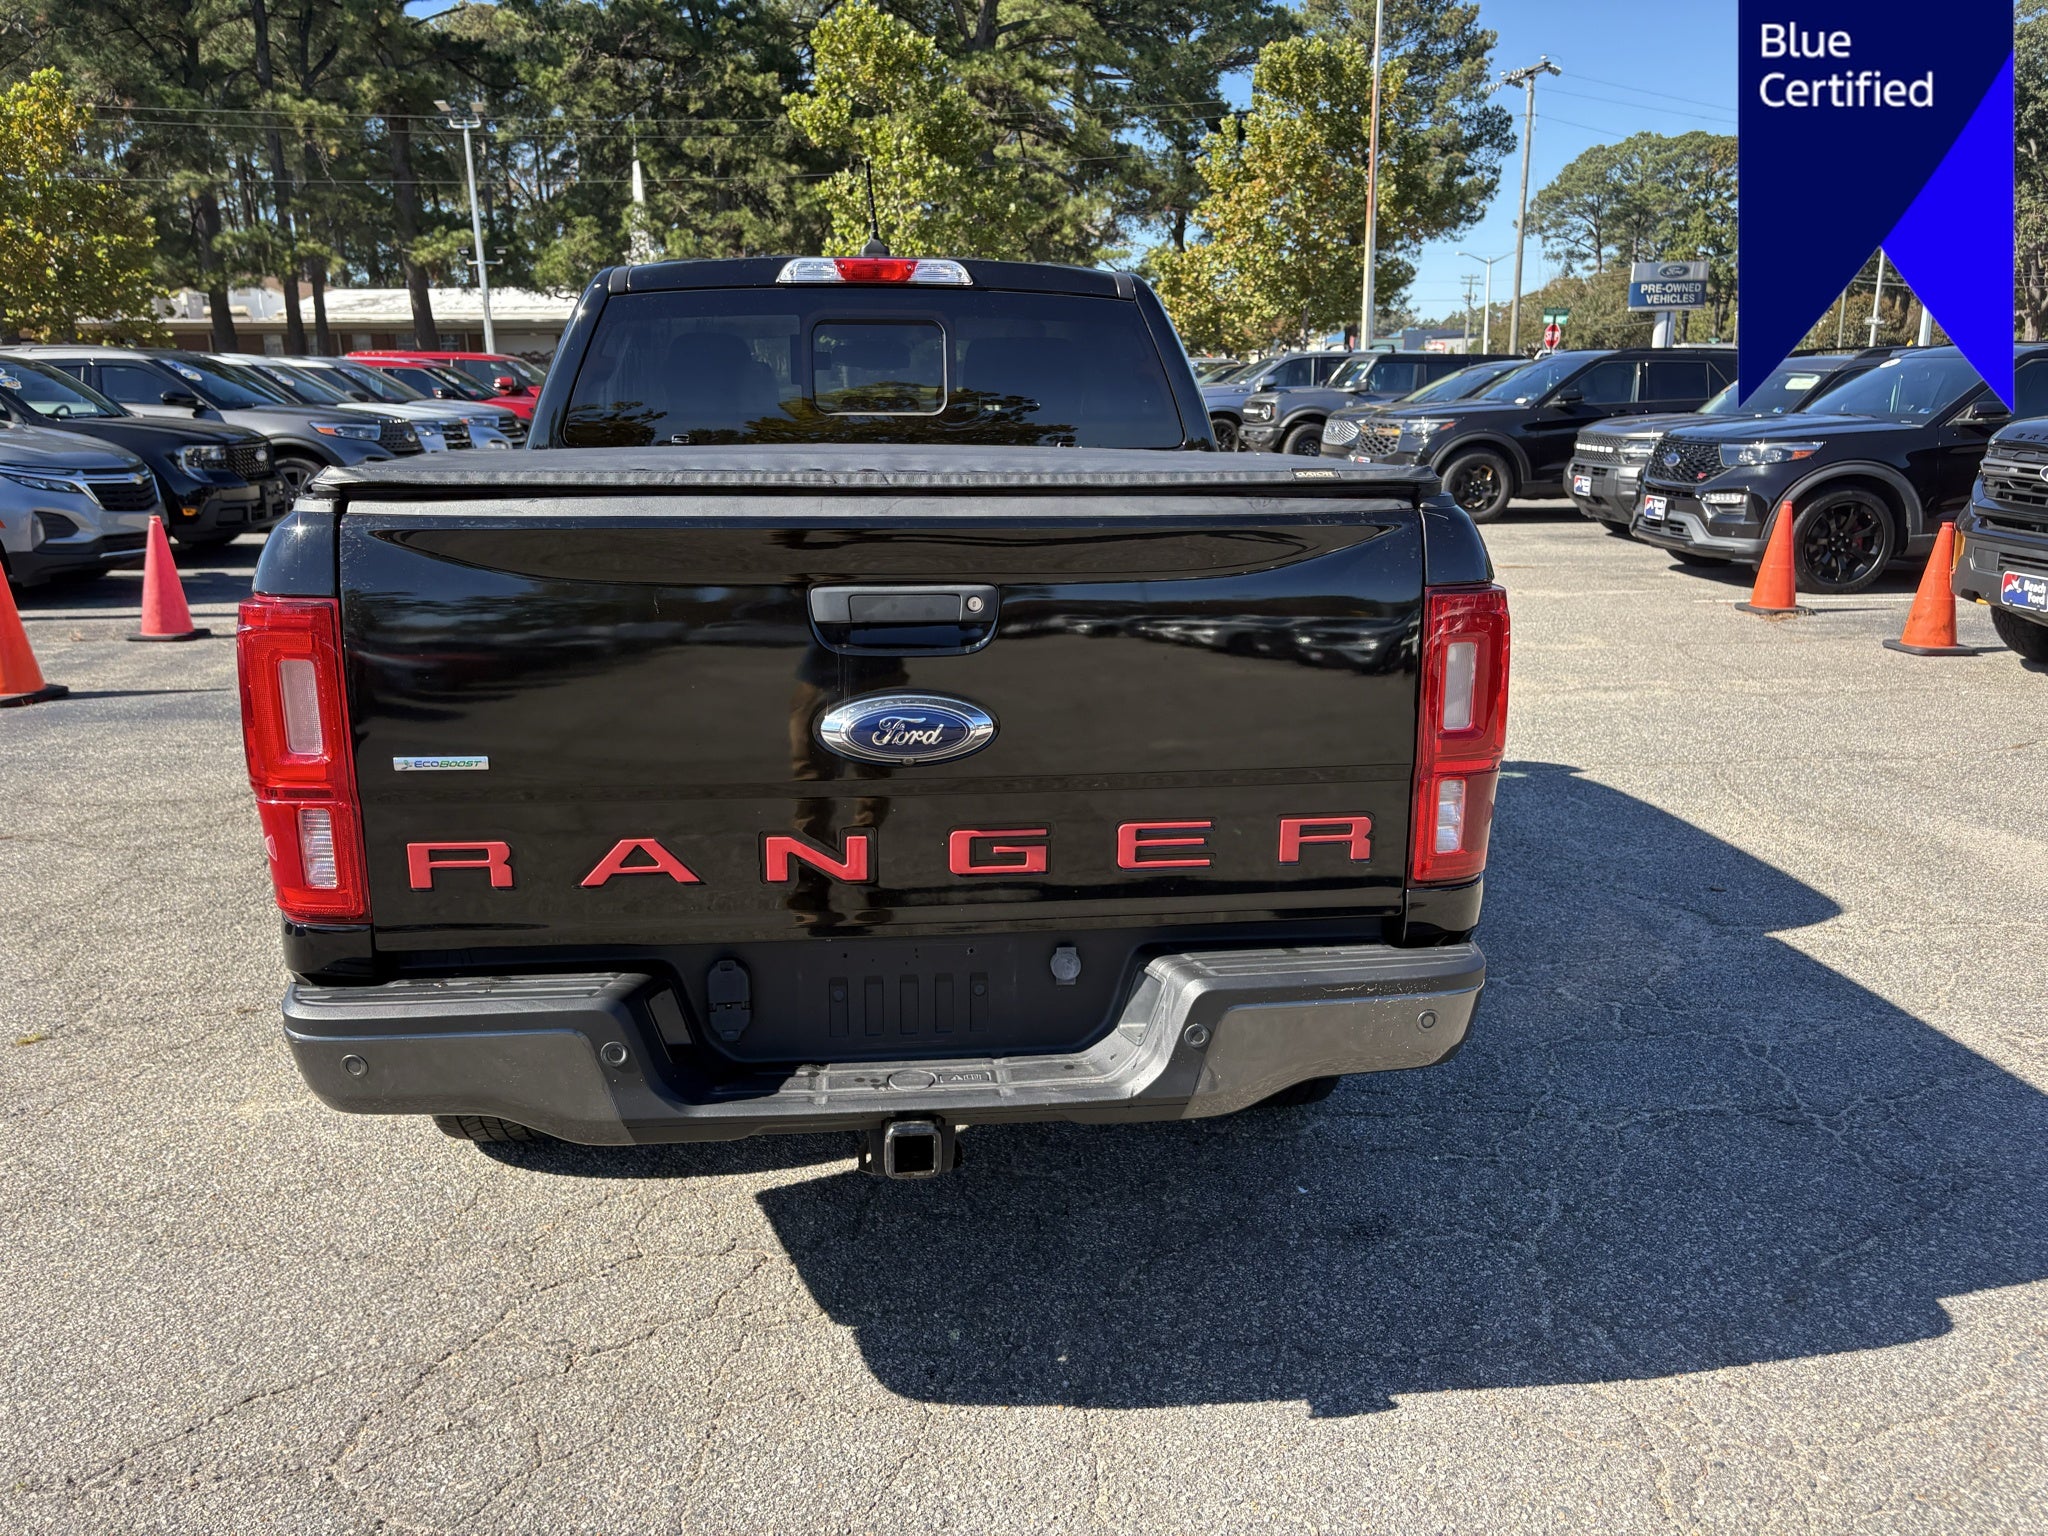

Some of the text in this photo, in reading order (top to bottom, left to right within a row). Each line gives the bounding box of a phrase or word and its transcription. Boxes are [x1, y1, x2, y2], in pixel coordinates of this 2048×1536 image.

[1640, 283, 1702, 293] PRE-OWNED
[1646, 293, 1696, 304] VEHICLES
[2023, 579, 2047, 594] Beach
[2027, 591, 2046, 606] Ford
[871, 716, 945, 746] Ford
[414, 760, 482, 768] ECOBOOST
[406, 815, 1373, 889] RANGER
